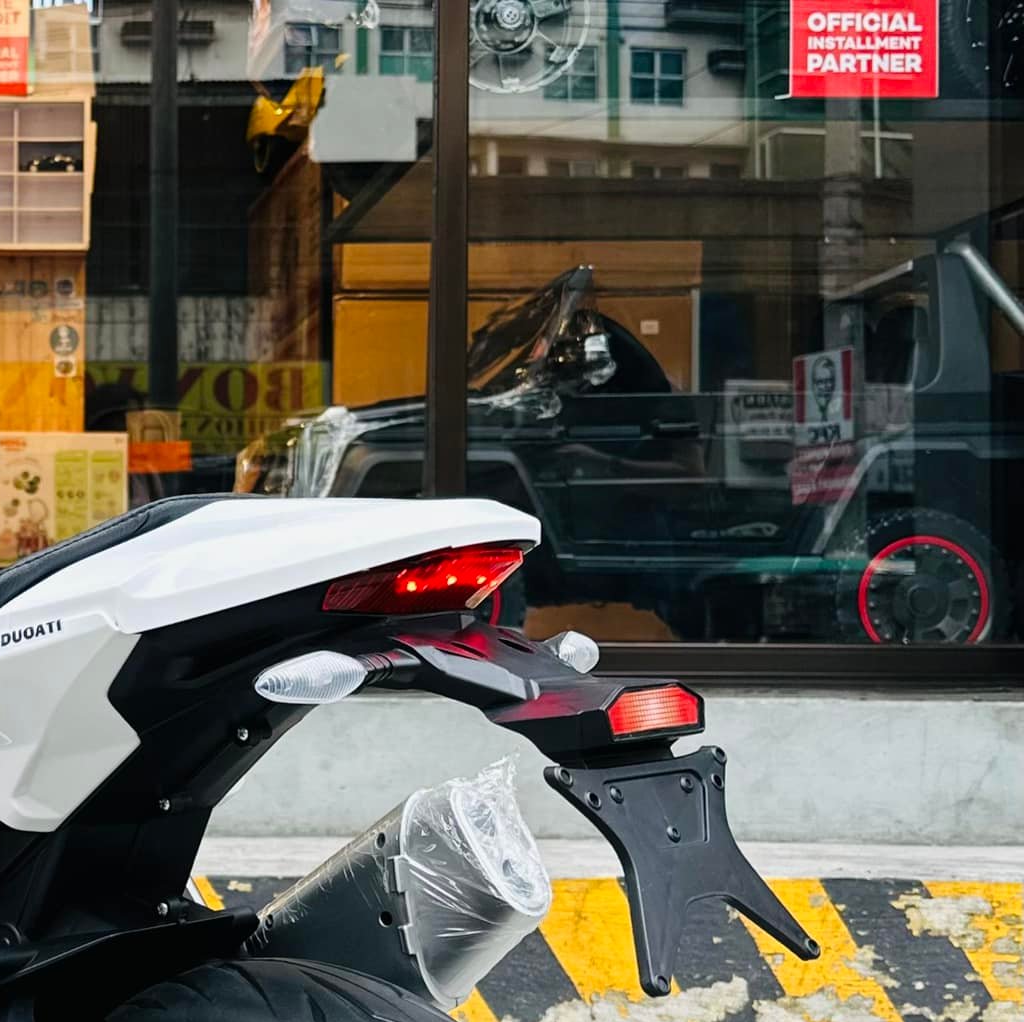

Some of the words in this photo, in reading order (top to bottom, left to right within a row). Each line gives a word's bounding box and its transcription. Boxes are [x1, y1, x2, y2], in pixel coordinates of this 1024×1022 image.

[807, 12, 923, 32] OFFICIAL
[807, 36, 922, 50] INSTALLMENT
[807, 53, 923, 73] PARTNER
